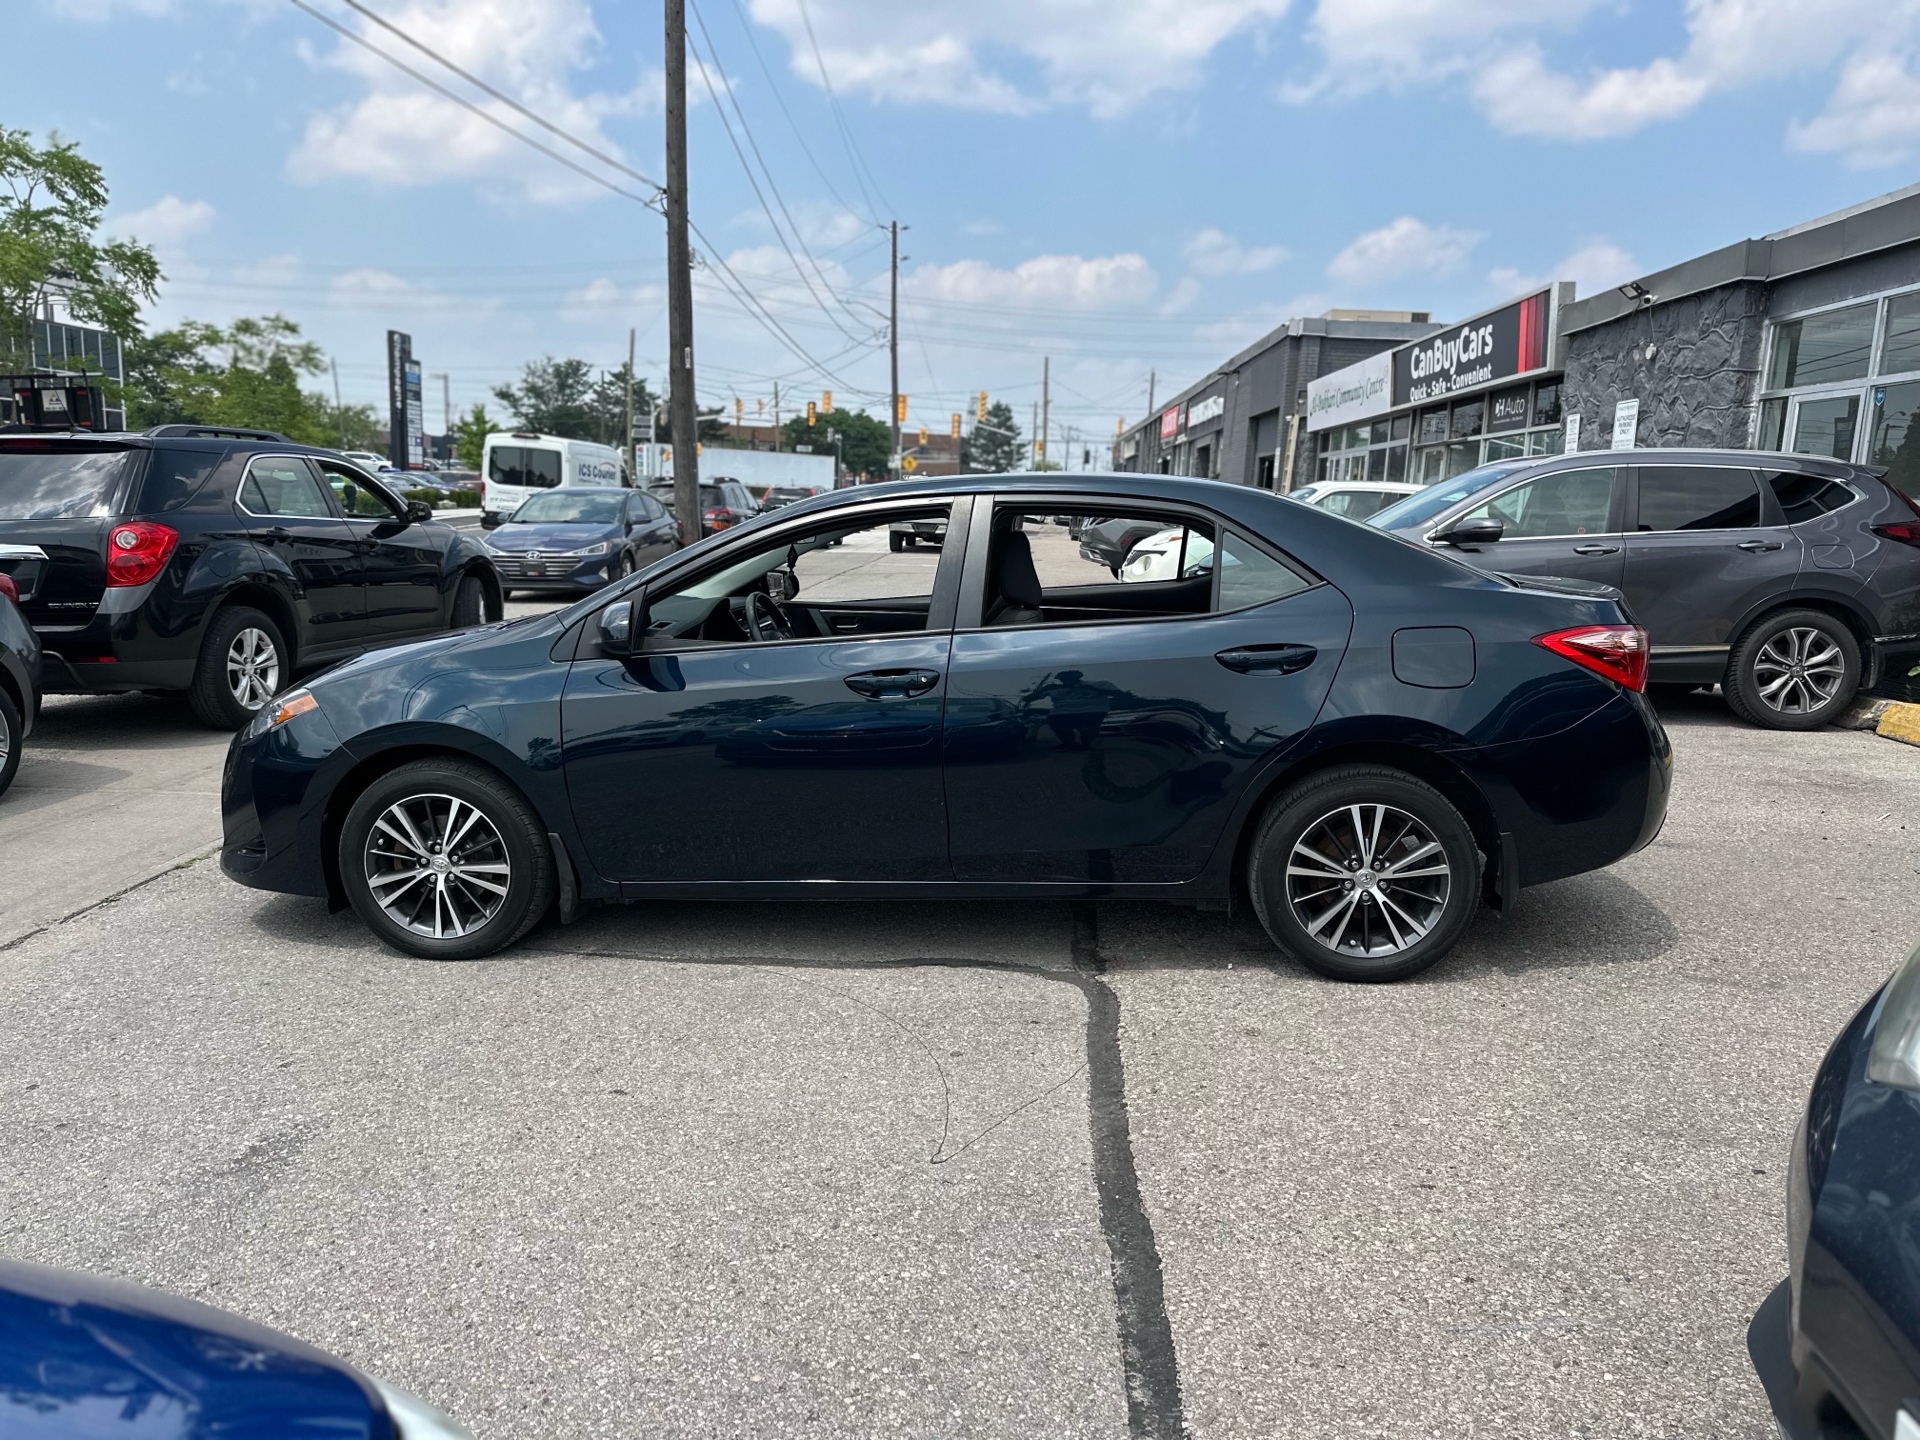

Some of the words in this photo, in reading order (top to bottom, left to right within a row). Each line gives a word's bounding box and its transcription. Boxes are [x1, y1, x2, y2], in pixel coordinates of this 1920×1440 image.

[1411, 324, 1493, 379] CanBuyCars
[1410, 383, 1427, 402] Quick
[1431, 377, 1446, 396] Safe
[1451, 363, 1492, 390] Convenient
[1505, 396, 1525, 415] Auto
[578, 463, 591, 477] ICS
[592, 465, 616, 480] Courier
